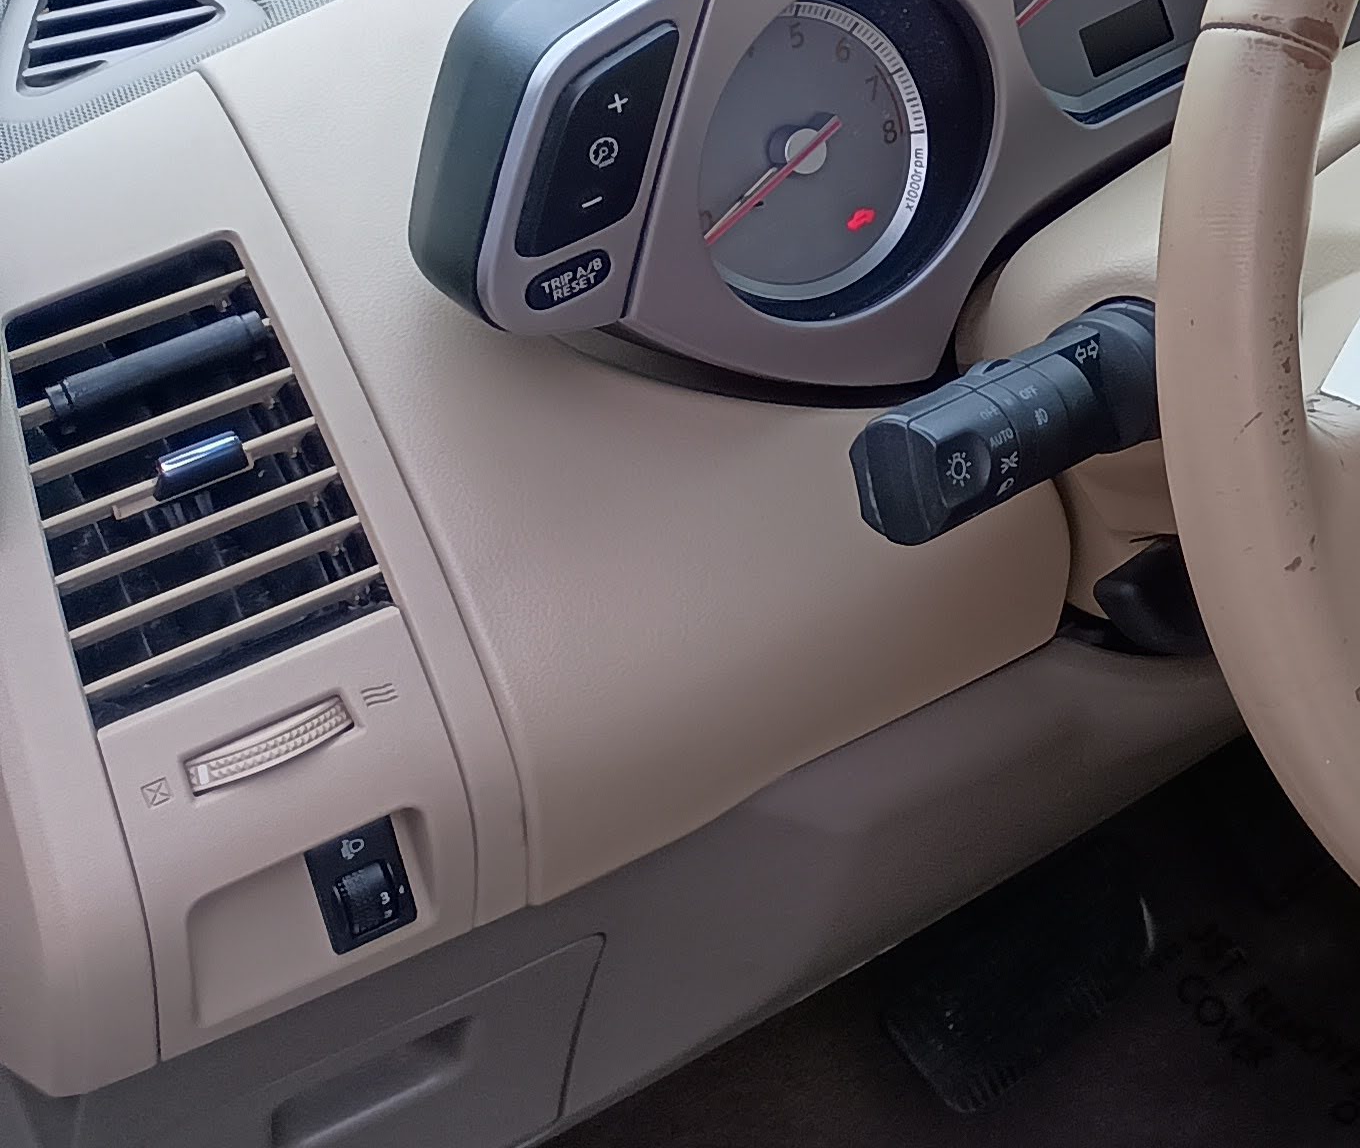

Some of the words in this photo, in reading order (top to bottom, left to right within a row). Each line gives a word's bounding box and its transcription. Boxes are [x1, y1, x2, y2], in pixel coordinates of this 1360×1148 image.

[788, 23, 804, 48] 5
[836, 38, 851, 62] 6
[865, 75, 879, 100] 7
[882, 120, 898, 144] 8
[904, 147, 925, 212] x1000rpm
[541, 271, 573, 294] TRIP
[576, 257, 603, 279] A/B
[553, 272, 597, 301] RESET
[1019, 385, 1038, 400] OFF
[989, 428, 1014, 450] AUTO
[380, 891, 390, 905] 3
